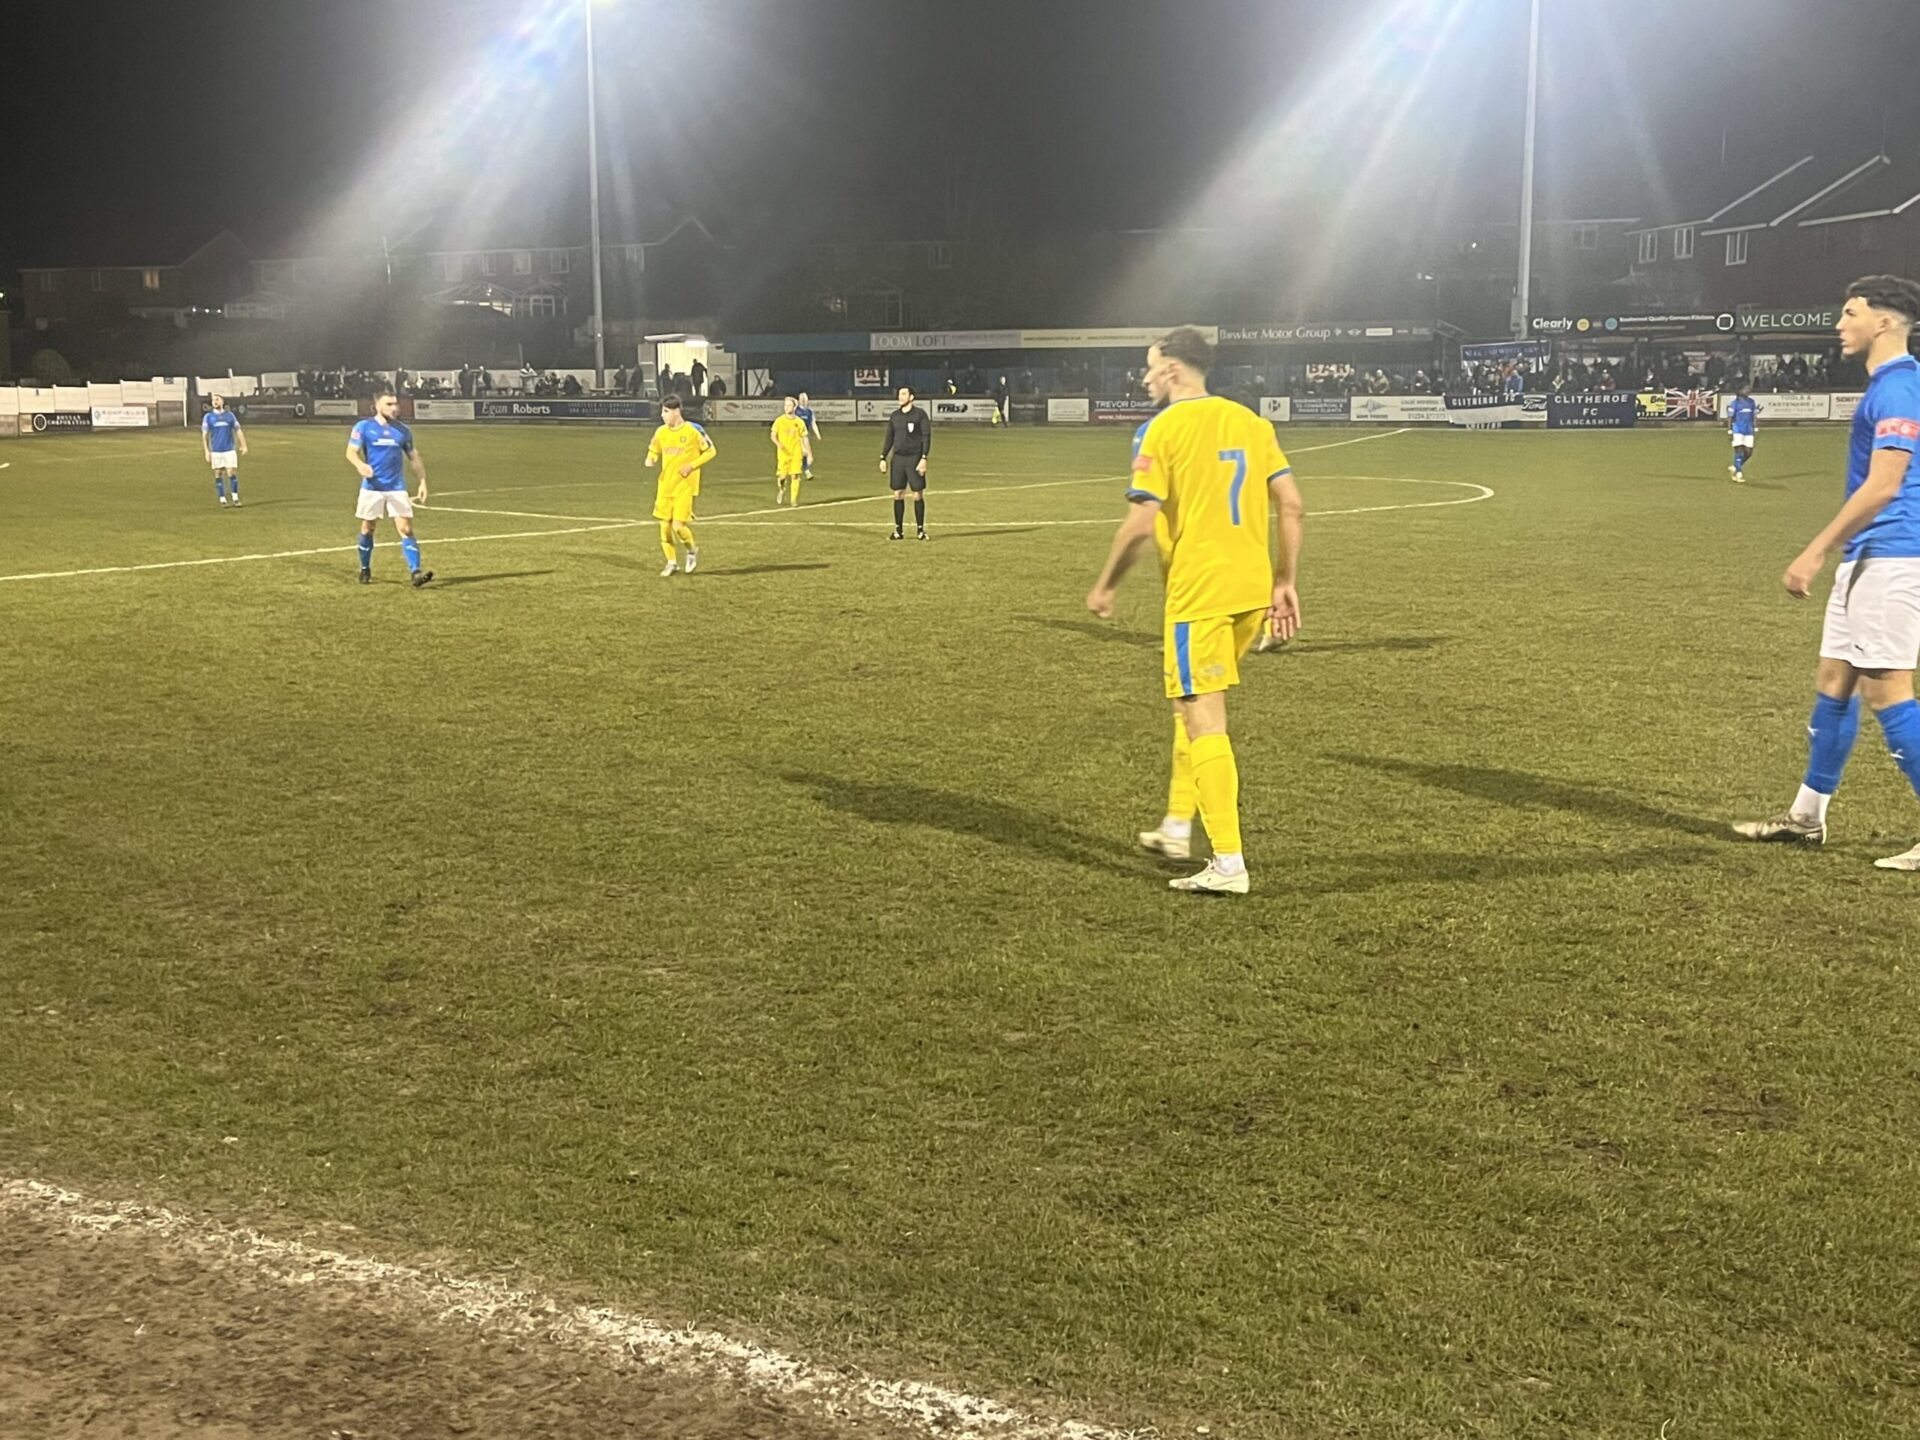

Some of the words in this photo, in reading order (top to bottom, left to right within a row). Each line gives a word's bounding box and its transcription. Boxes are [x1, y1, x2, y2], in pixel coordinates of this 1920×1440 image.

[1532, 317, 1573, 331] Clearly
[1741, 313, 1832, 328] WELCOME
[1260, 327, 1293, 339] Motor
[1296, 326, 1331, 341] Group
[915, 334, 947, 347] LOFT
[1309, 363, 1347, 374] BAR
[1452, 396, 1498, 406] CLITHEROE
[1521, 400, 1547, 410] Ford
[1554, 394, 1629, 404] CLITHEROE
[481, 402, 508, 416] Egan
[513, 404, 550, 414] Roberts
[1583, 408, 1598, 416] FC
[1559, 418, 1621, 426] LANCASHIRE
[1218, 448, 1246, 526] 7
